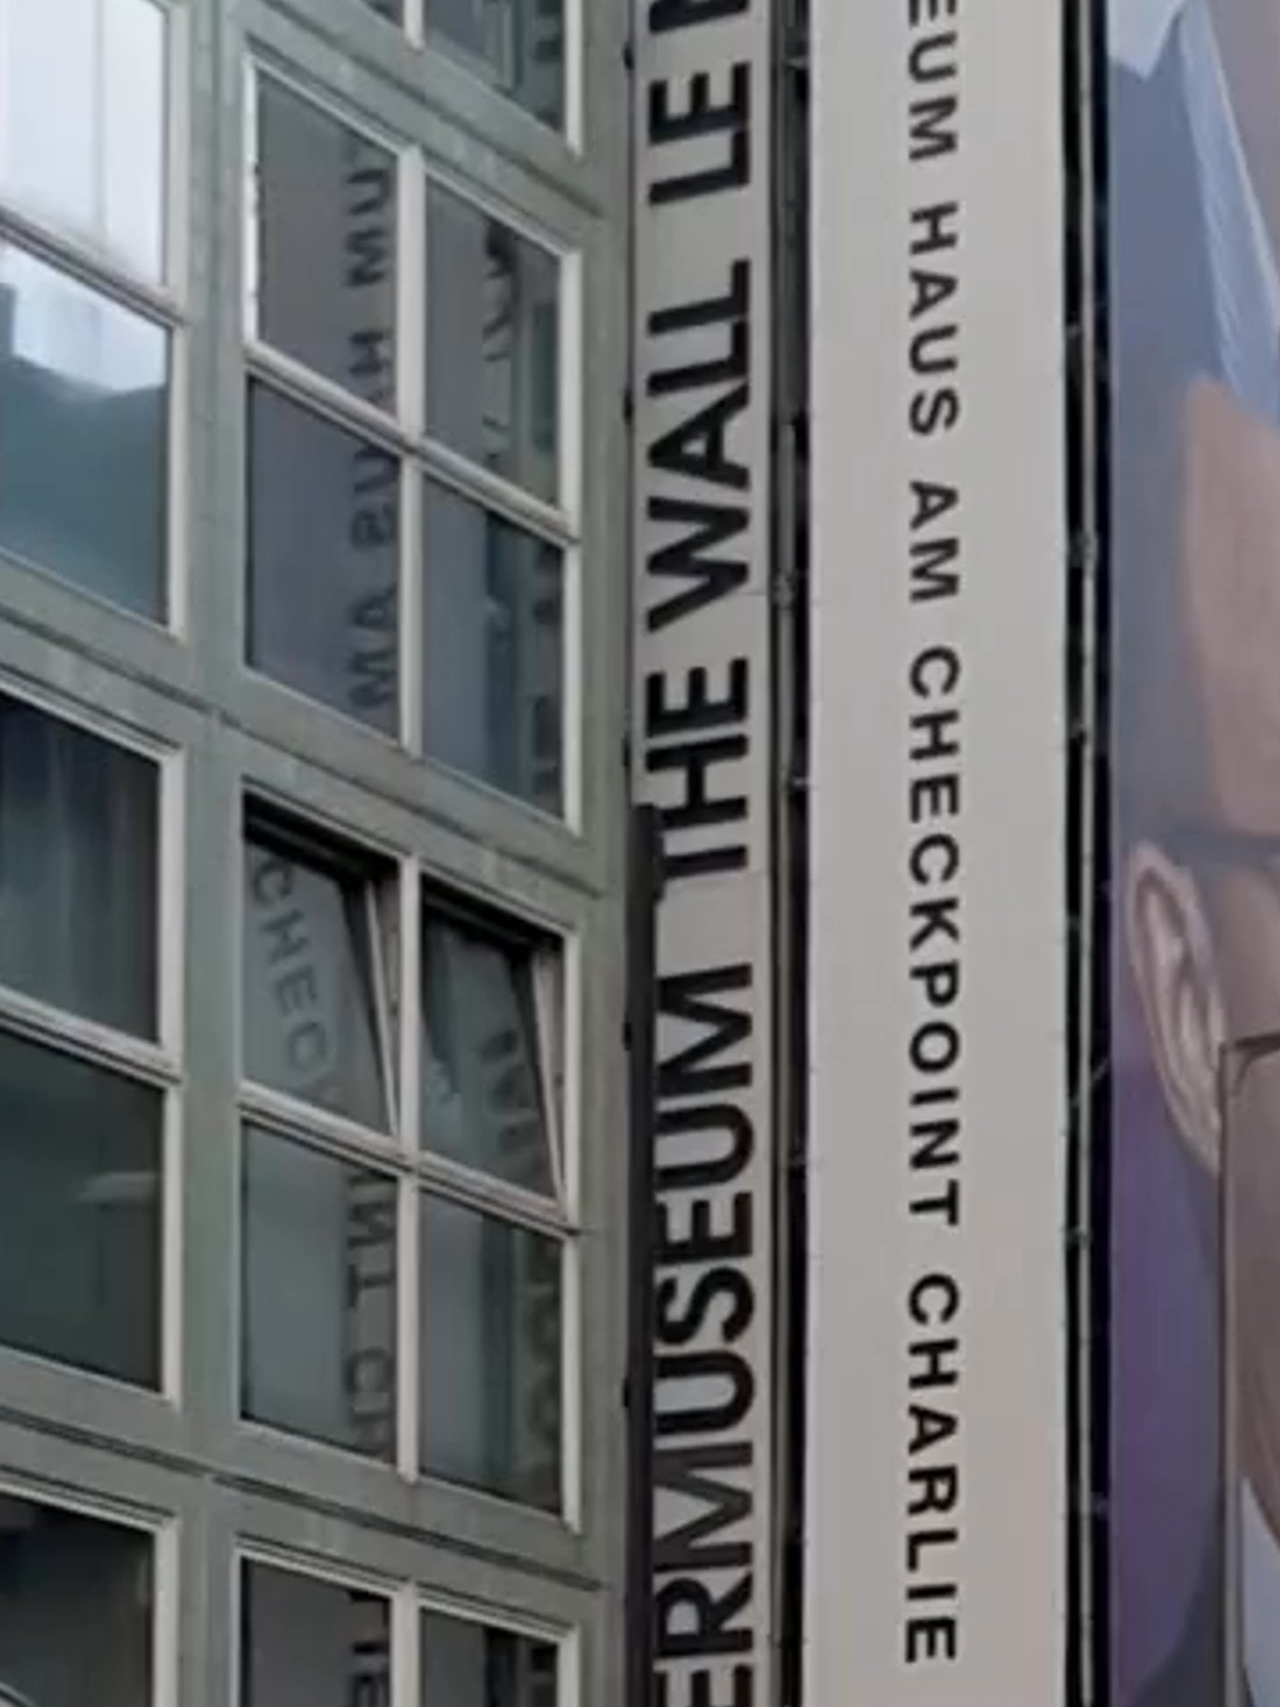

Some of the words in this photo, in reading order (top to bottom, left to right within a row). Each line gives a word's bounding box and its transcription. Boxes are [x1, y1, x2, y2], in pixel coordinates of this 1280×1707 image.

[646, 61, 752, 204] LE
[909, 201, 959, 435] HAUS
[646, 257, 752, 631] WALL
[909, 479, 959, 603] AM
[646, 657, 750, 882] THE
[908, 646, 959, 1227] CHECKPOINT
[905, 1273, 959, 1663] CHARLIE
